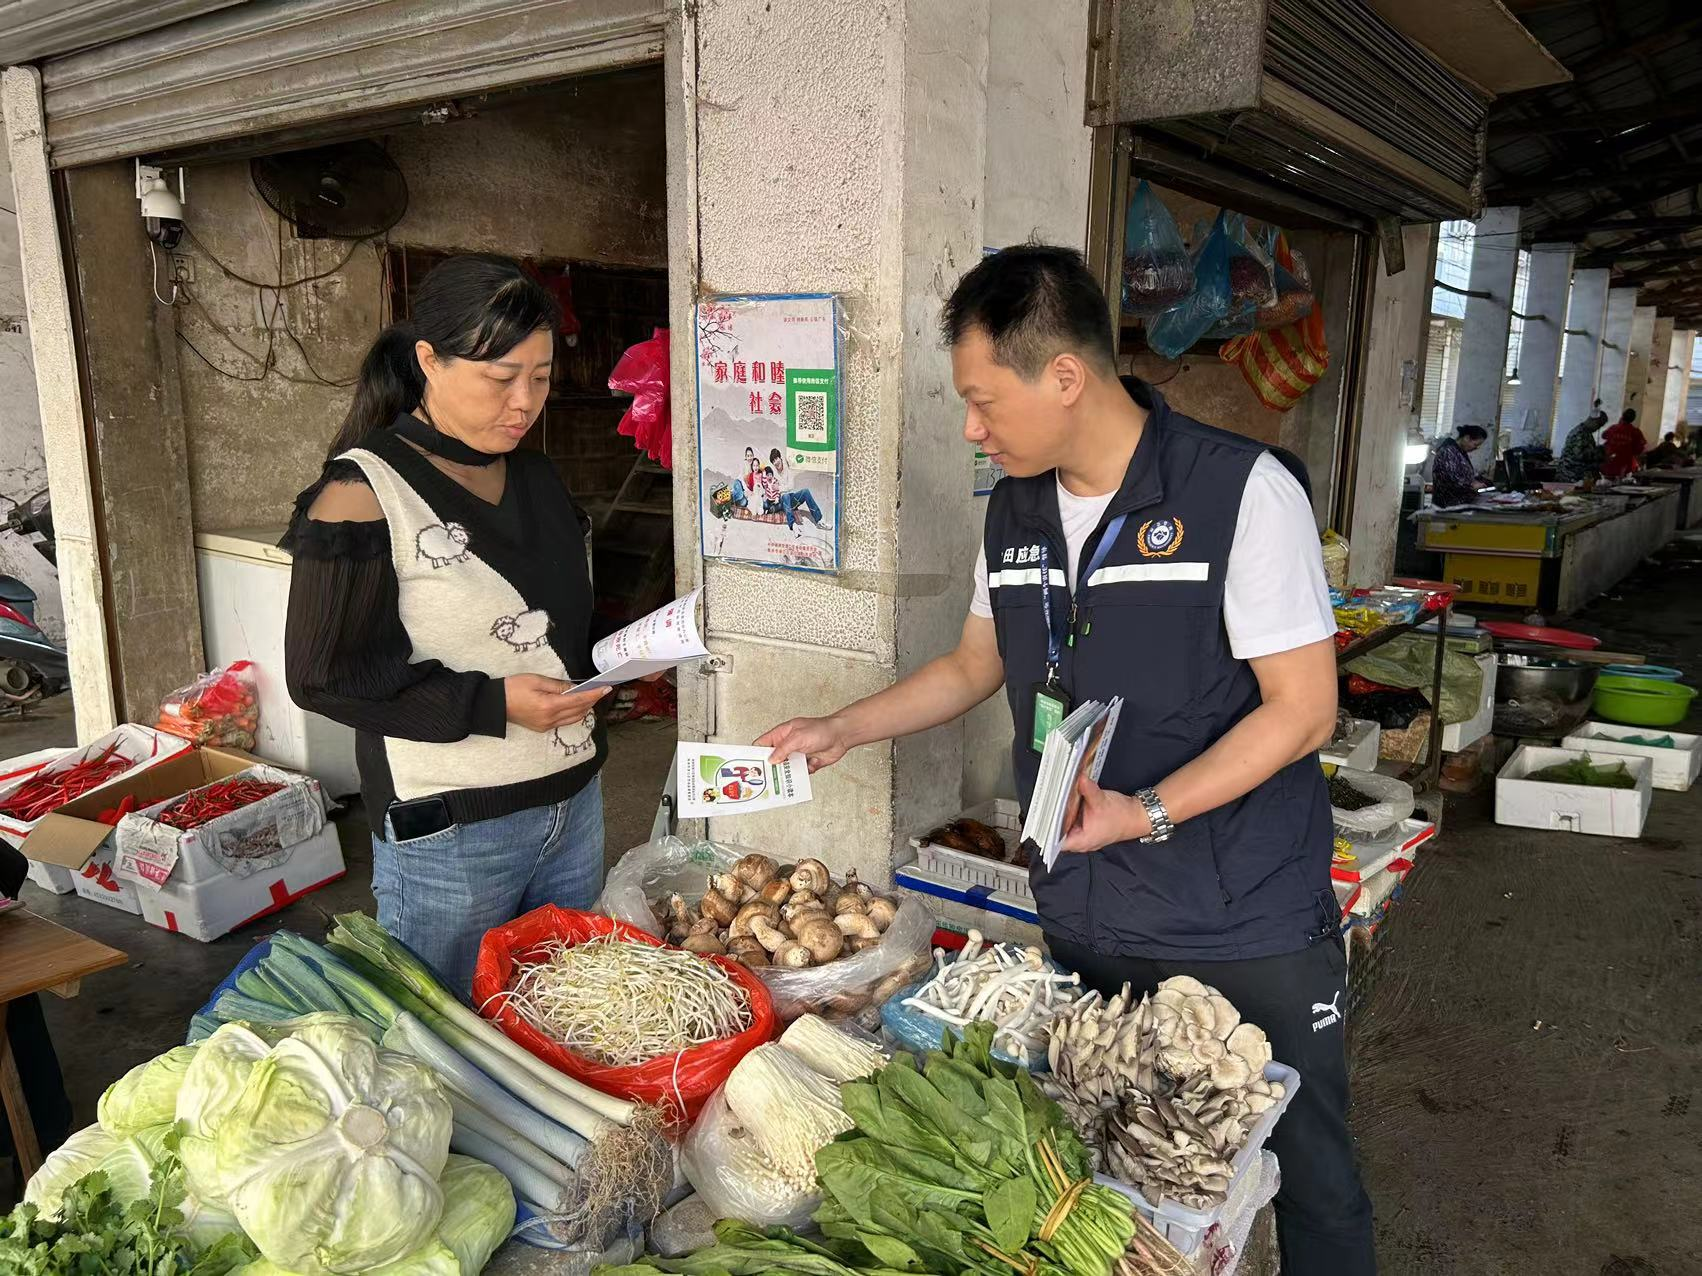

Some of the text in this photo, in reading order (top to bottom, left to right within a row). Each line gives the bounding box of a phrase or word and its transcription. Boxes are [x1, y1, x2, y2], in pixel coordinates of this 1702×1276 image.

[715, 361, 785, 384] 家庭和睦
[749, 391, 782, 414] 社会
[1001, 545, 1040, 564] 田应急
[1311, 1013, 1337, 1033] PUMA
